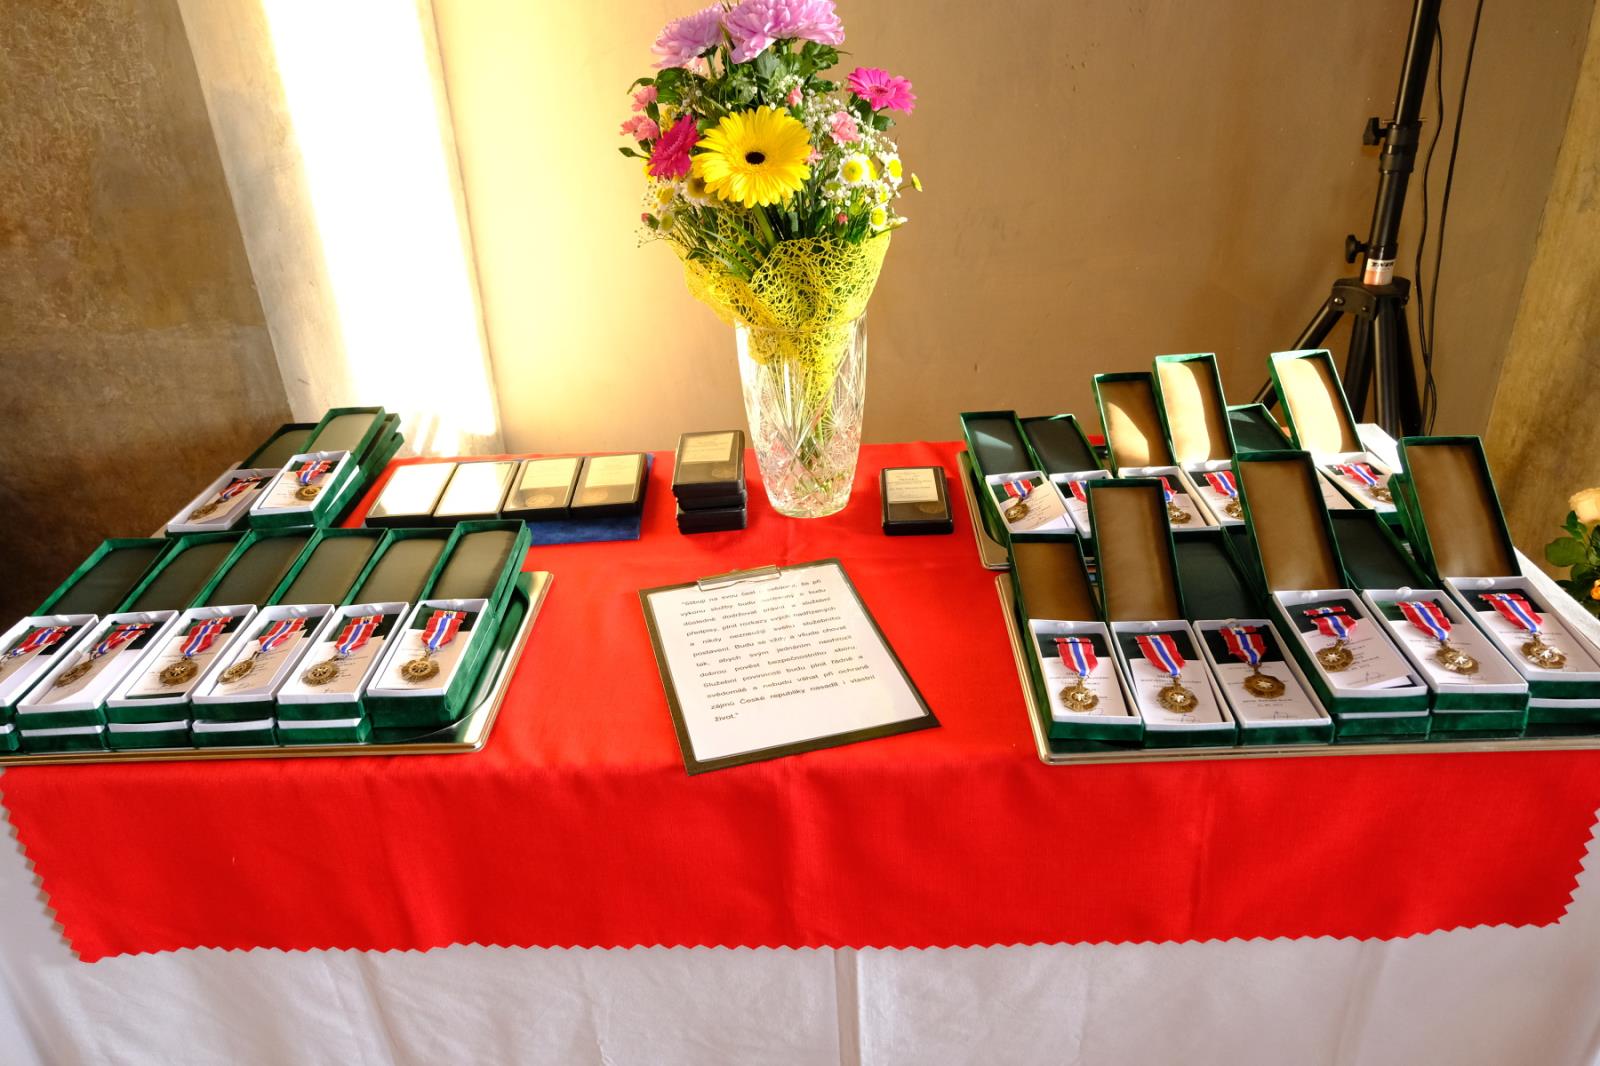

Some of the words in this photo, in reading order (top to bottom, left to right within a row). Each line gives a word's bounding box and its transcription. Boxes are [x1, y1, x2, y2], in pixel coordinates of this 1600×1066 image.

[734, 641, 754, 649] Budu
[761, 678, 792, 689] nebudu
[739, 695, 765, 705] České
[769, 687, 805, 699] republiky
